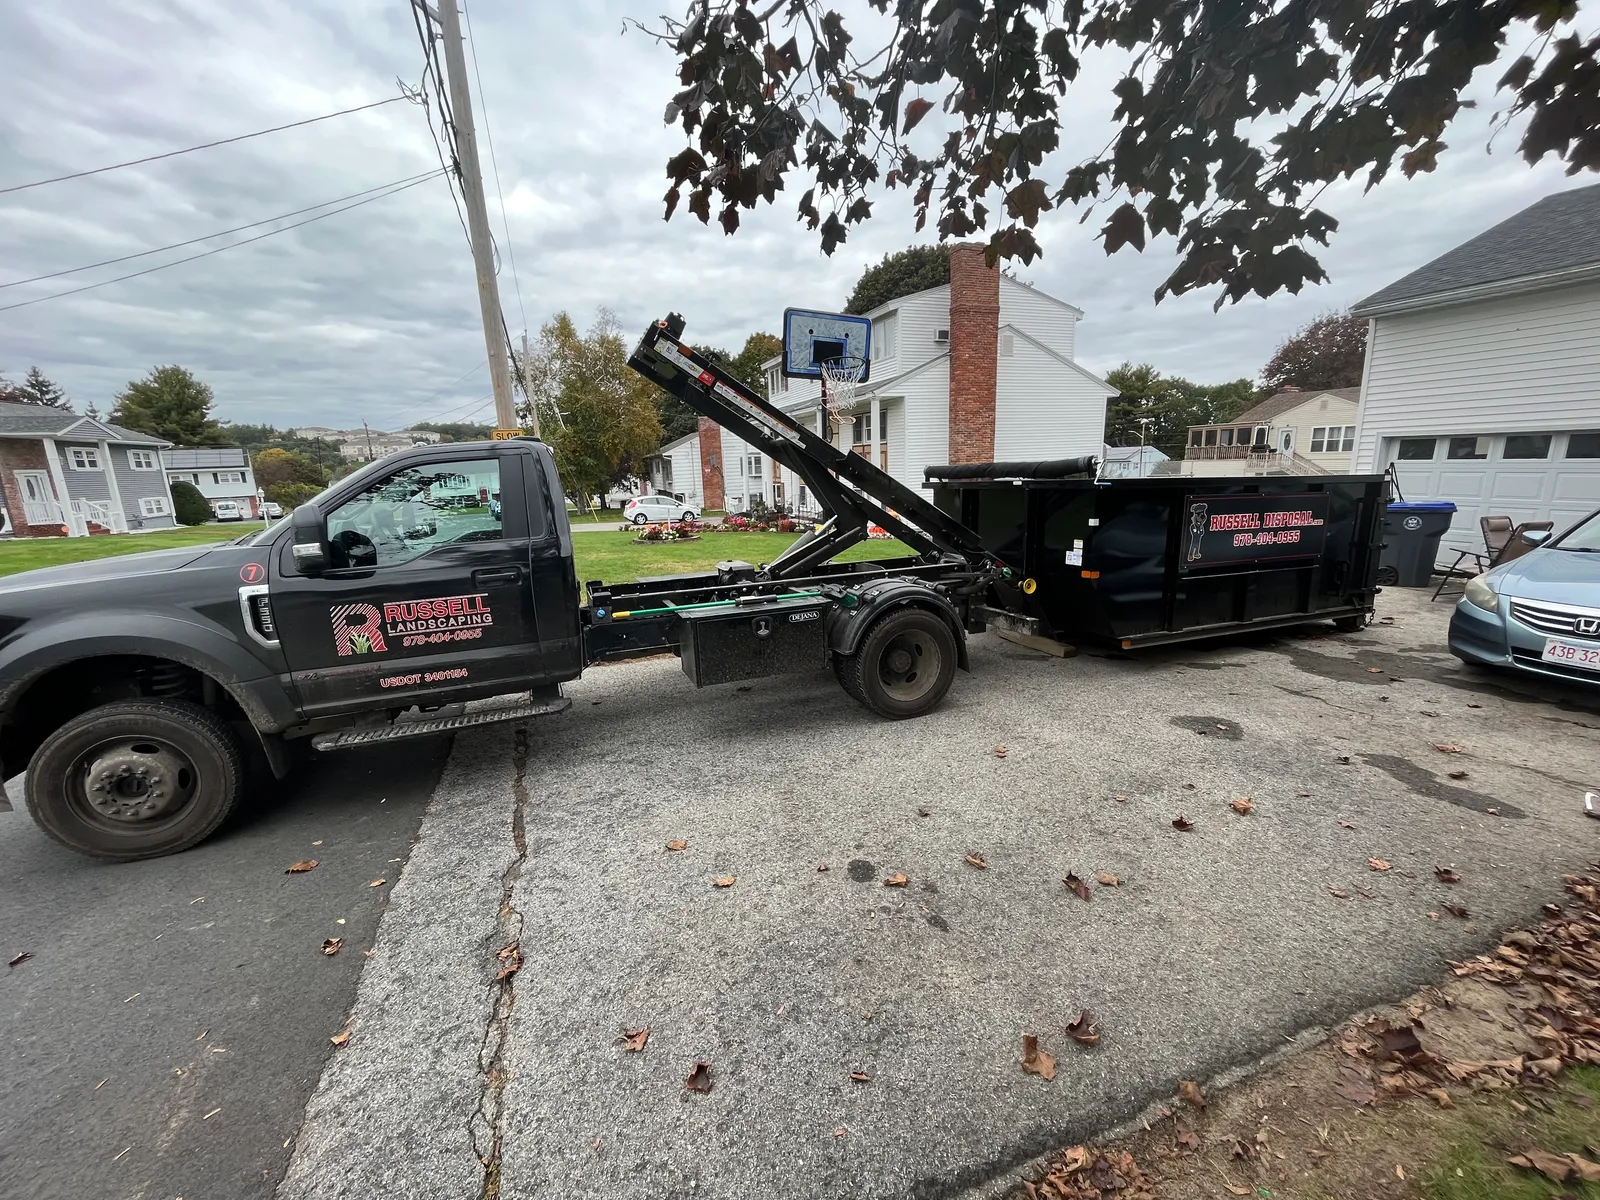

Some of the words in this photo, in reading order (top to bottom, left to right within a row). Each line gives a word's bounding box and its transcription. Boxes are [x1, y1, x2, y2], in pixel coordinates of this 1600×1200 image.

[1209, 513, 1261, 531] RUSSELL
[1233, 530, 1300, 547] 978-404-0955
[247, 566, 257, 580] 7
[384, 597, 491, 623] RUSSELL
[791, 612, 818, 621] DEJANA
[387, 613, 493, 634] LANDSCAPING
[402, 628, 483, 647] 978-404-0955
[1548, 645, 1576, 660] 43B
[1579, 649, 1600, 664] 32
[380, 673, 421, 688] USDOT
